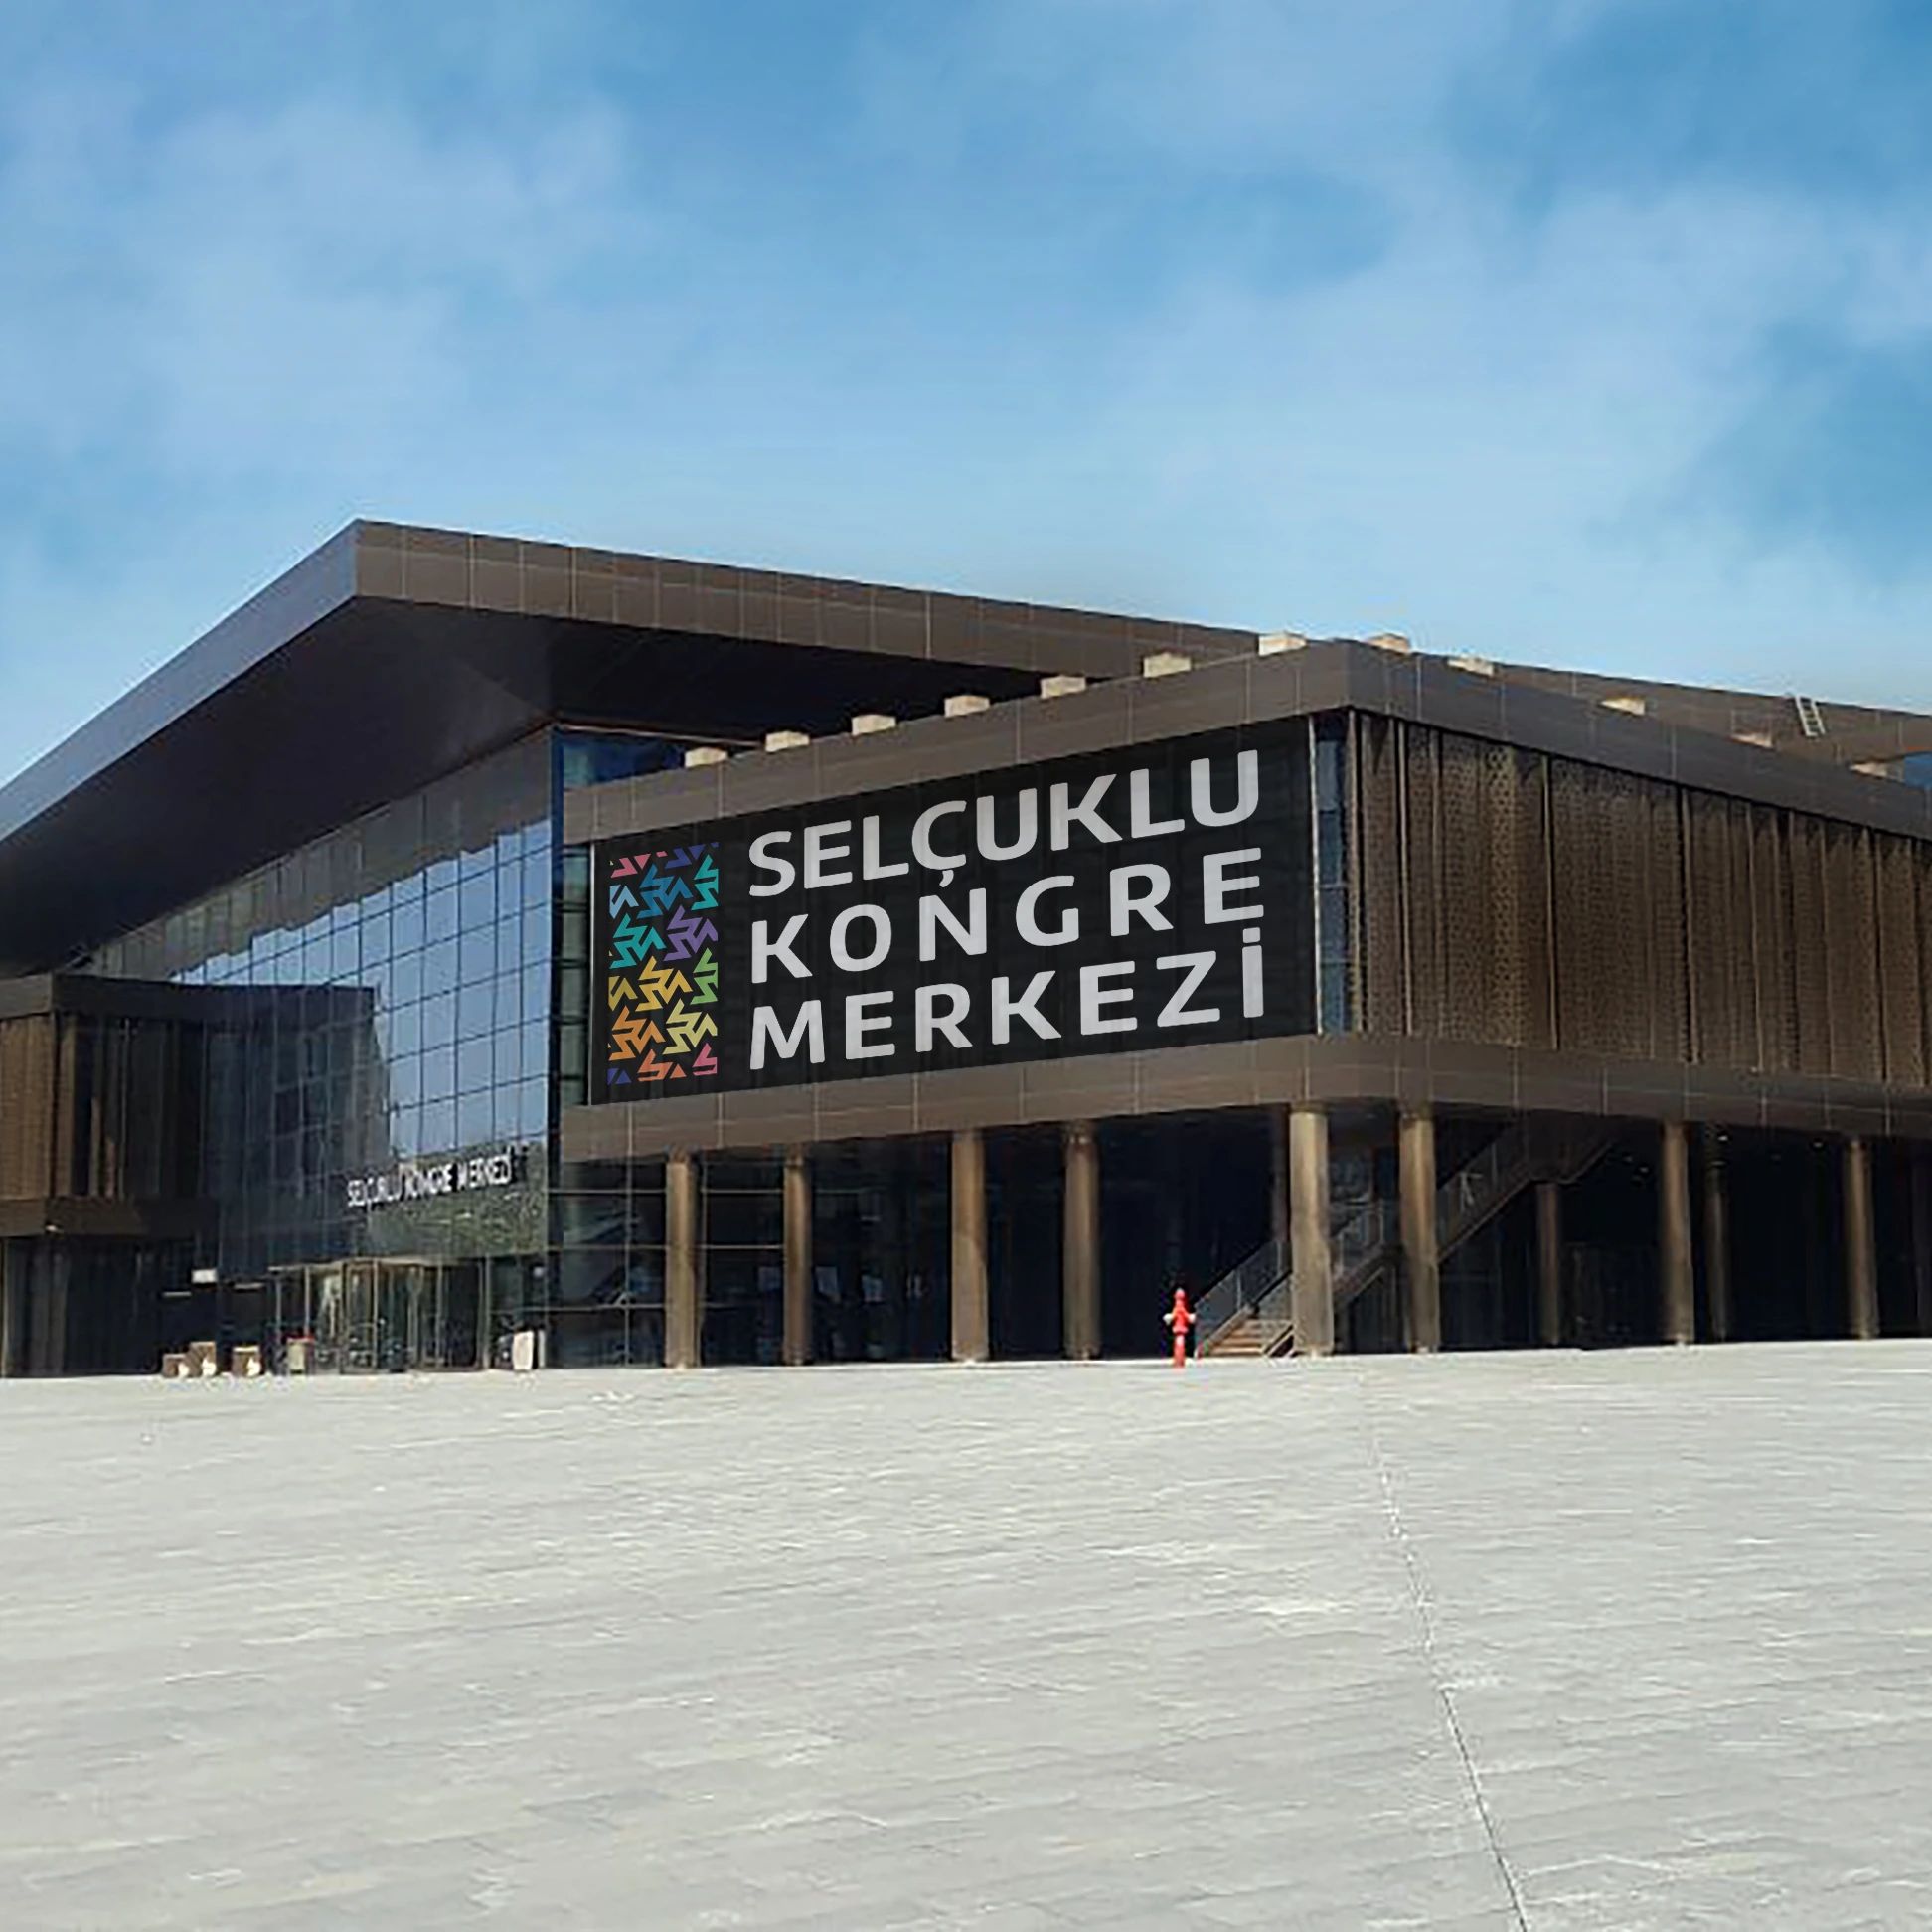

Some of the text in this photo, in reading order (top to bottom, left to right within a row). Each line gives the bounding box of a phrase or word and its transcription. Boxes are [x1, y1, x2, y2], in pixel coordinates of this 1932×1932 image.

[749, 750, 1259, 896] SELÇUKLU
[751, 848, 1264, 984] KONGRE
[749, 926, 1264, 1070] MERKEZİ
